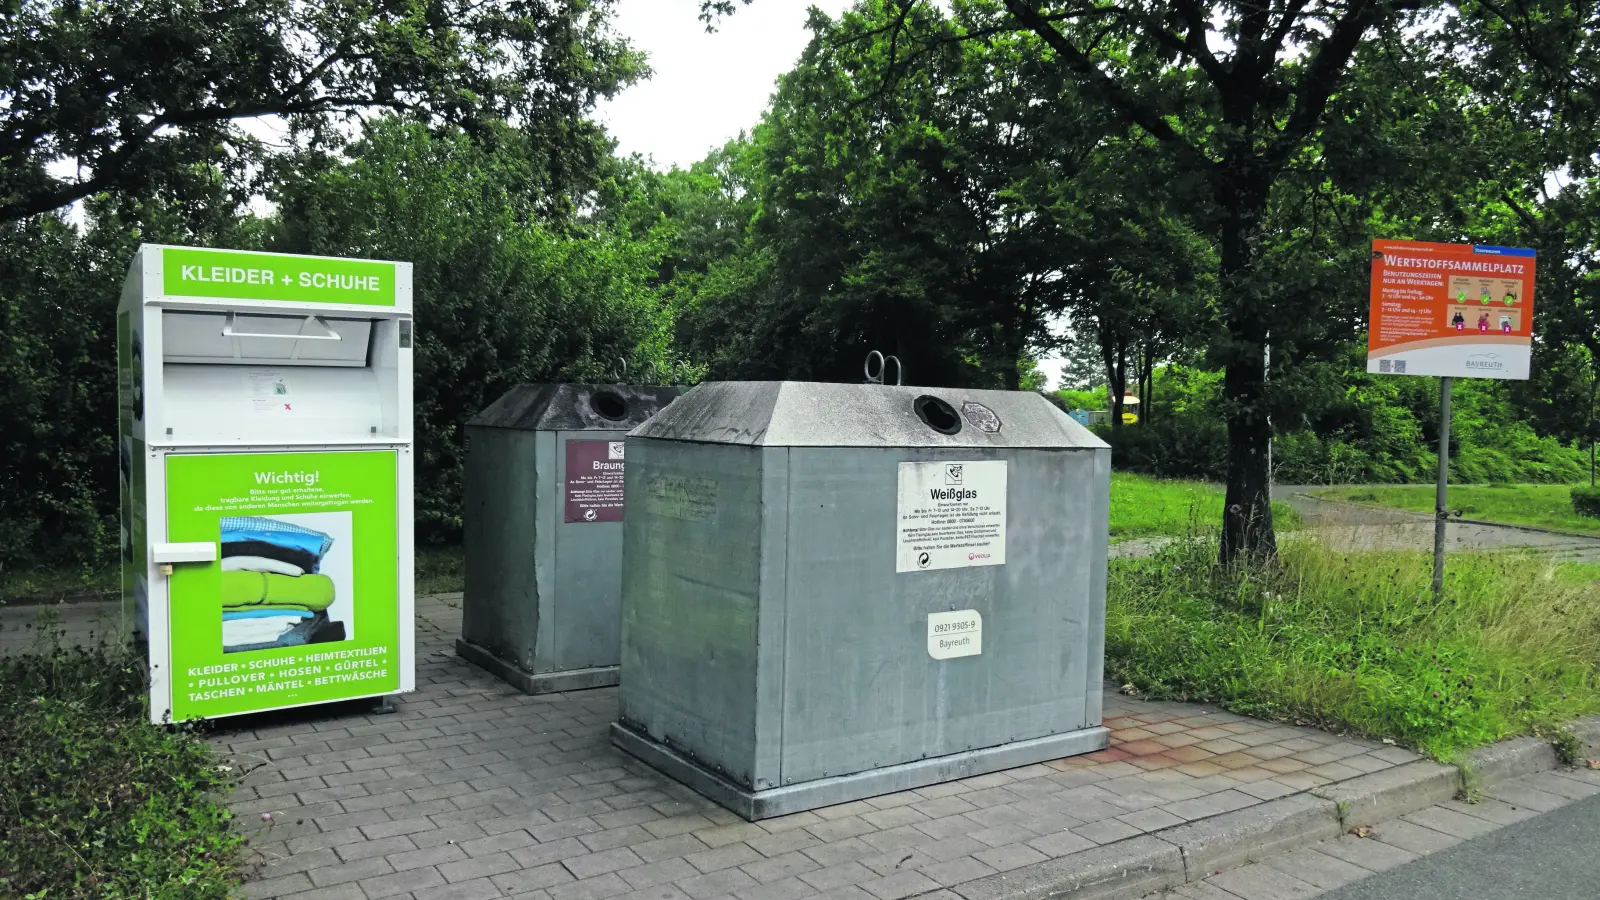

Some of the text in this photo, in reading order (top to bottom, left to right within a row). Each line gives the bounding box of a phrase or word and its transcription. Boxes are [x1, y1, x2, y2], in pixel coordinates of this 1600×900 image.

[1384, 254, 1524, 274] WERTSTOFFSAMMELPLATZ
[182, 265, 275, 285] KLEIDER
[298, 271, 380, 291] SCHUHE
[593, 460, 625, 472] Braung
[254, 470, 319, 487] Wichtig!
[220, 496, 249, 504] tragbare
[251, 495, 280, 503] Kleidung
[930, 487, 977, 502] Weißglas
[239, 502, 266, 510] anderen
[934, 620, 976, 633] 0921 9305-9
[939, 636, 970, 650] Bayreuth
[188, 646, 387, 677] KLEIDER SCHUHE HEIMTEXTILIEN
[199, 659, 378, 688] PULLOVER HOSEN GÜRTEL
[188, 669, 387, 702] TASCHEN MÄNTEL BETTWÄSCHE
